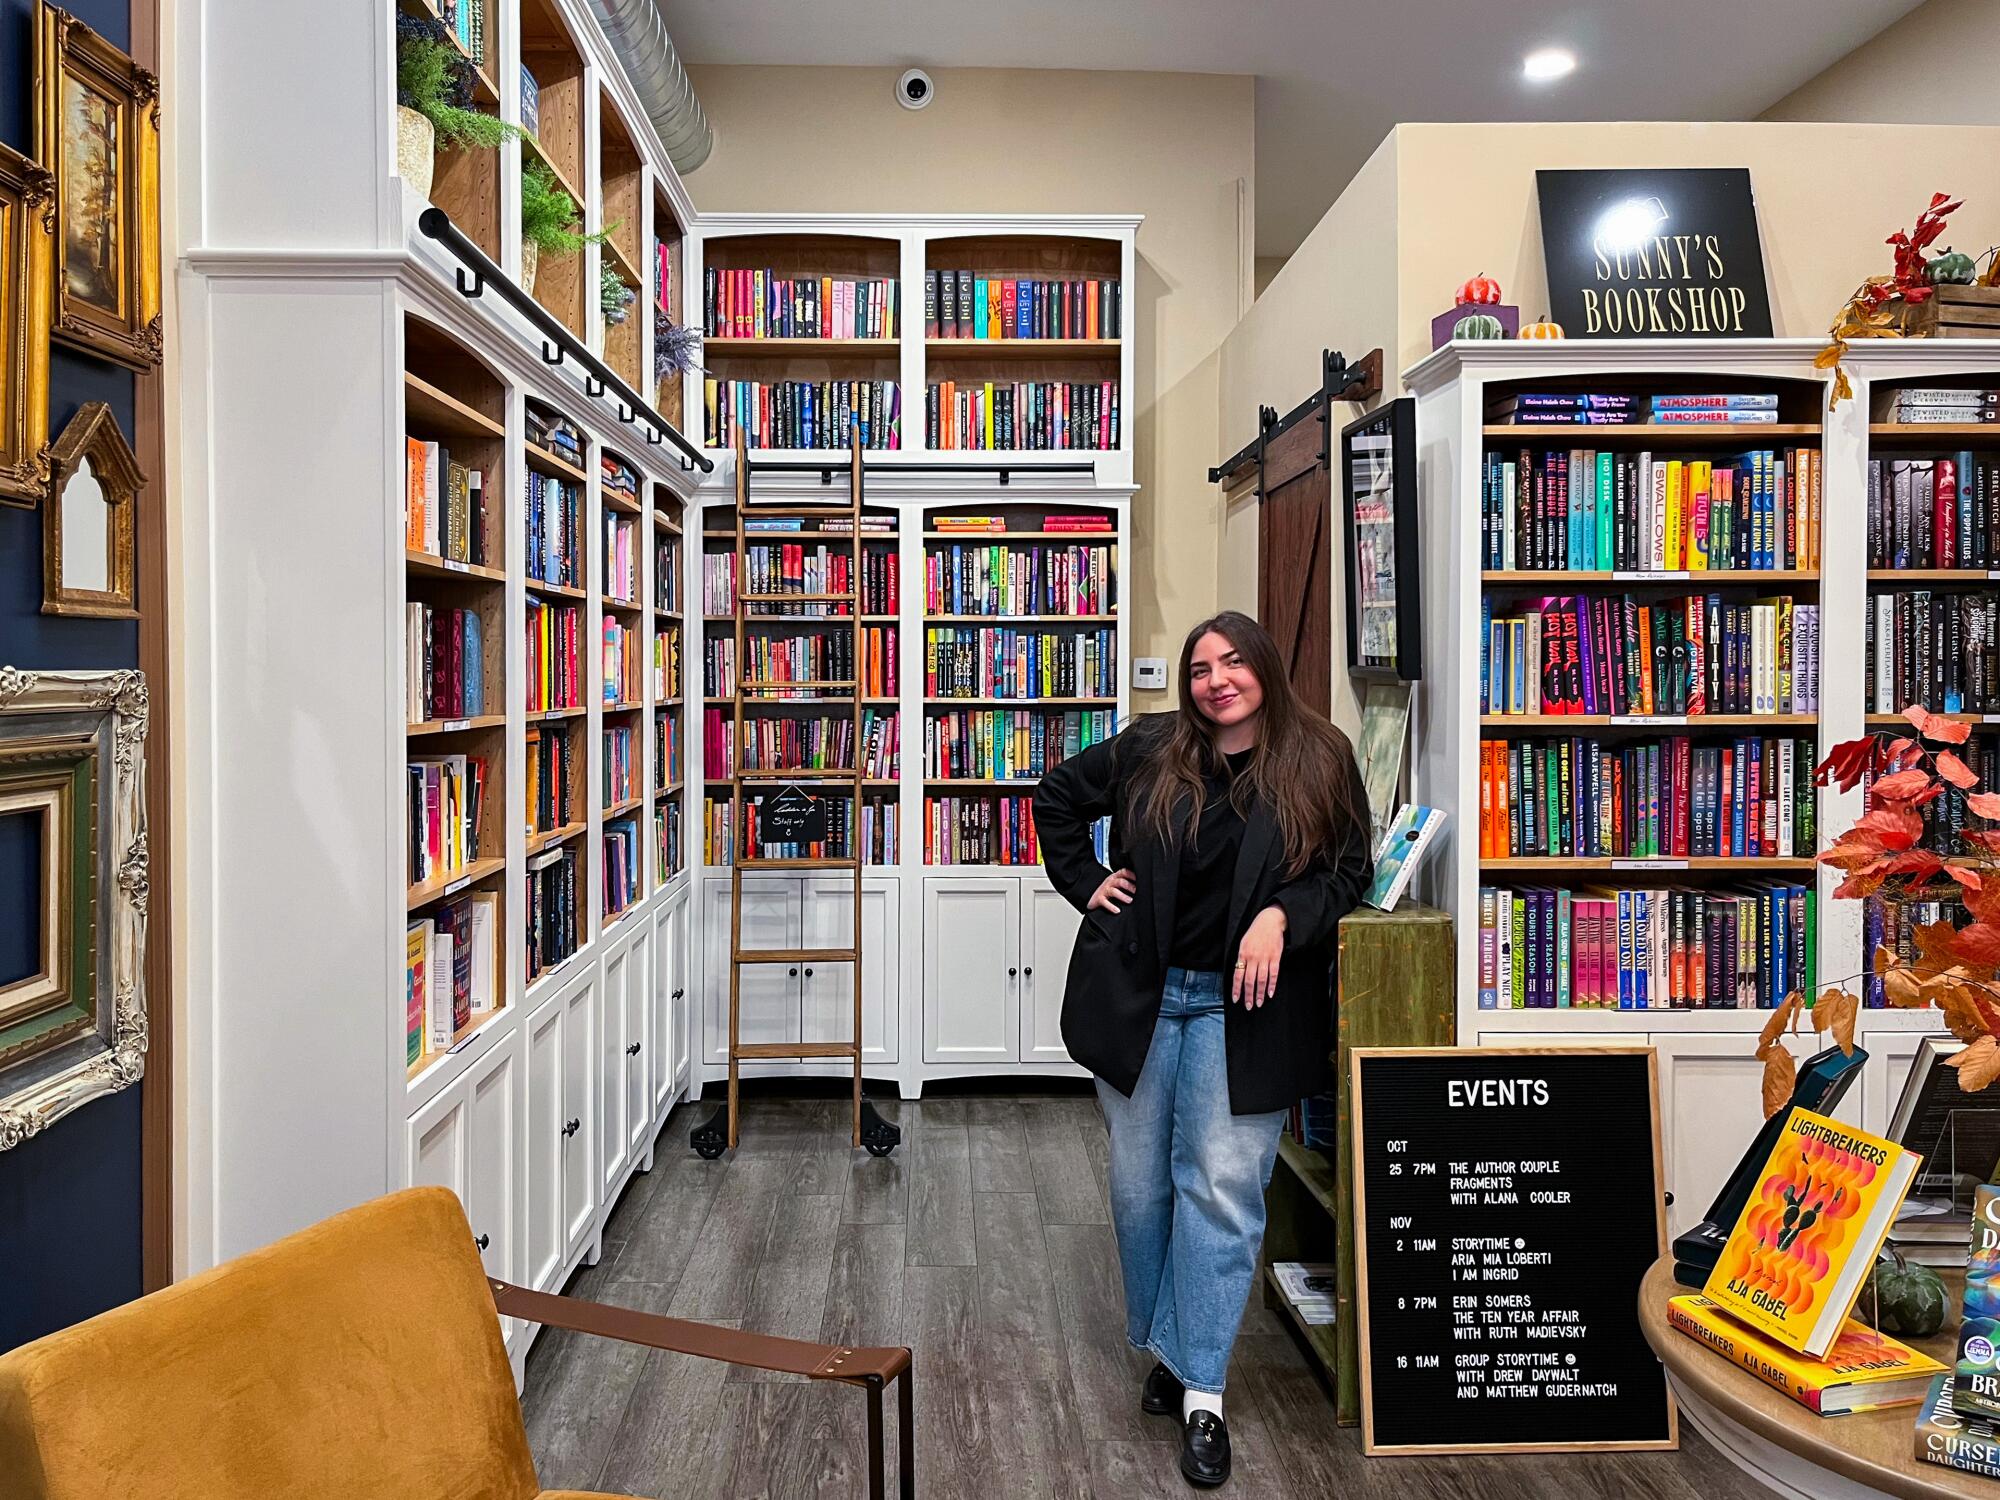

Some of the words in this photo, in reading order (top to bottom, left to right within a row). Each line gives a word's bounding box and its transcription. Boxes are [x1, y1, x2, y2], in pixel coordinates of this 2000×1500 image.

[1593, 233, 1724, 281] SUNNY'S
[1581, 287, 1746, 333] BOOKSHOP
[1660, 398, 1728, 407] ATMOSPHERE
[1663, 412, 1729, 421] ATMOSPHERE
[1547, 458, 1556, 472] THE
[1558, 458, 1566, 472] THE
[1799, 454, 1807, 469] THE
[1547, 477, 1556, 516] INTRUDER
[1558, 478, 1567, 517] INTRUDER
[1655, 469, 1664, 561] SWALLOWS
[1697, 494, 1707, 524] TRUTH
[1697, 529, 1706, 538] IS
[1796, 623, 1807, 665] EXQUISITE
[1810, 623, 1818, 665] EXQUISITE
[1951, 610, 1959, 661] aftertaste
[1710, 607, 1719, 700] AMITY
[1781, 674, 1790, 696] PAN
[1798, 672, 1807, 698] THINGS
[1811, 672, 1819, 698] THINGS
[1696, 774, 1703, 787] we
[1708, 773, 1714, 786] we
[1751, 762, 1759, 799] BITTER
[1696, 792, 1704, 808] fell
[1708, 792, 1716, 807] fell
[1694, 812, 1703, 839] apart
[1706, 812, 1714, 838] apart
[1751, 803, 1759, 841] SWEET
[1484, 894, 1492, 925] BUCKEYE
[1621, 920, 1630, 948] LOVED
[1636, 920, 1647, 949] LOVED
[1484, 934, 1492, 963] PATRICK
[1764, 948, 1769, 958] US
[1502, 956, 1510, 975] PLAY
[1621, 951, 1631, 971] ONE
[1637, 952, 1647, 971] ONE
[1484, 966, 1492, 984] RYAN
[1502, 980, 1510, 997] NICE
[1448, 1080, 1549, 1106] EVENTS
[1387, 1141, 1408, 1152] OCT
[1790, 1117, 1887, 1167] LIGHTBREAKERS
[1390, 1164, 1402, 1175] 25
[1413, 1163, 1435, 1175] 7PM
[1449, 1162, 1468, 1174] THE
[1475, 1162, 1516, 1173] AUTHOR
[1521, 1161, 1560, 1173] COUPLE
[1451, 1177, 1512, 1189] FRAGMENTS
[1451, 1193, 1476, 1204] WITH
[1484, 1193, 1518, 1204] ALANA
[1530, 1192, 1570, 1203] COOLER
[1391, 1217, 1411, 1228] NOV
[1397, 1240, 1403, 1251] 2
[1414, 1239, 1435, 1251] 11AM
[1452, 1238, 1510, 1250] STORYTIME
[1452, 1254, 1475, 1265] ARIA
[1484, 1253, 1502, 1265] MIA
[1507, 1253, 1551, 1264] LOBERTI
[1453, 1270, 1456, 1280] I
[1463, 1269, 1477, 1280] AM
[1483, 1268, 1518, 1280] INGRID
[1398, 1298, 1405, 1309] 8
[1414, 1297, 1436, 1309] 7PM
[1453, 1296, 1477, 1308] ERIN
[1486, 1295, 1531, 1307] SOMERS
[1727, 1279, 1749, 1298] AJA
[1752, 1289, 1788, 1321] GABEL
[1453, 1312, 1474, 1323] THE
[1481, 1311, 1501, 1323] TEN
[1507, 1311, 1535, 1322] YEAR
[1542, 1310, 1579, 1322] AFFAIR
[1454, 1327, 1481, 1339] WITH
[1489, 1327, 1517, 1338] RUTH
[1527, 1326, 1586, 1338] MADIEVSKY
[1671, 1309, 1734, 1356] LIGHTBREAKERS
[1744, 1352, 1758, 1370] AJA
[1762, 1362, 1789, 1389] GABEL
[1397, 1356, 1407, 1368] 16
[1416, 1355, 1438, 1367] 11AM
[1455, 1354, 1489, 1367] GROUP
[1497, 1353, 1559, 1365] STORYTIME
[1832, 1363, 1858, 1375] AJA
[1860, 1359, 1910, 1370] GABEL
[1456, 1370, 1484, 1382] WITH
[1494, 1370, 1522, 1382] DREW
[1532, 1369, 1579, 1381] DAYWALT
[1457, 1386, 1478, 1398] AND
[1487, 1385, 1538, 1397] MATTHEW
[1546, 1384, 1616, 1396] GUDERNATCH
[1927, 1433, 2000, 1465] CURSE
